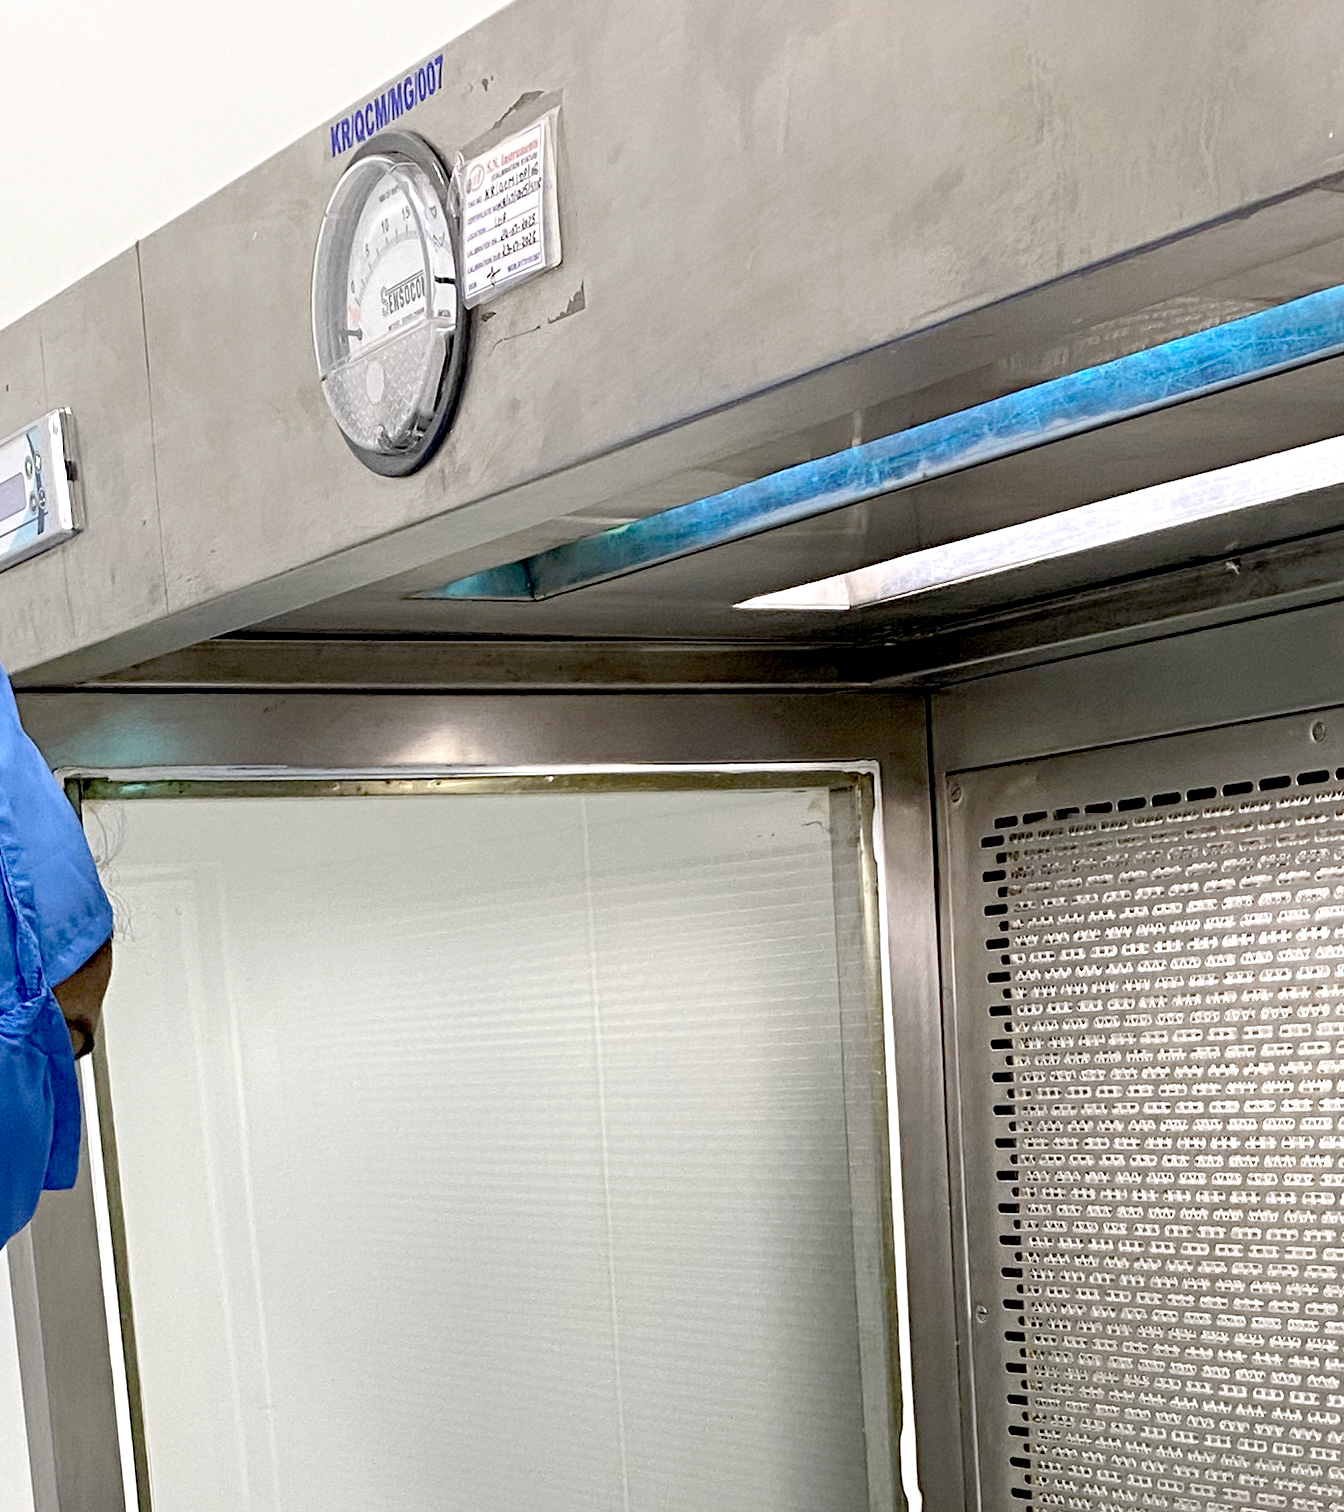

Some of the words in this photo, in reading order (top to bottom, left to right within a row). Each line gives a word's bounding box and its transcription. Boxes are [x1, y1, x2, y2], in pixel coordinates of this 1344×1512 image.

[330, 53, 444, 158] KR/QCM/MG/007
[401, 205, 411, 220] 15
[381, 218, 389, 234] 10
[365, 243, 370, 258] 5
